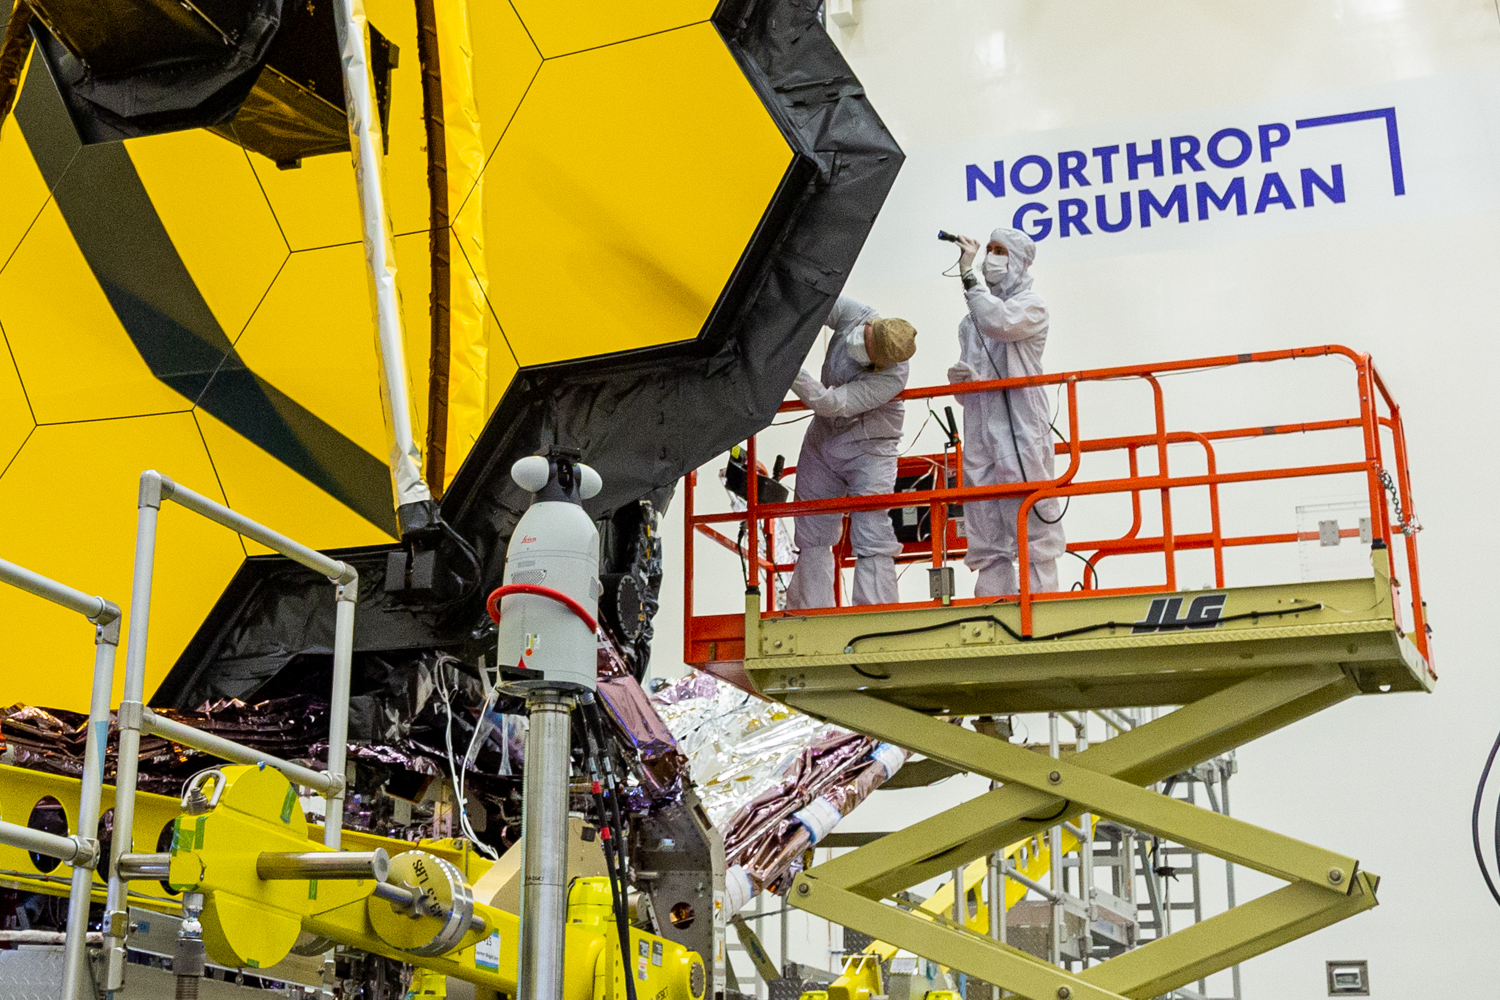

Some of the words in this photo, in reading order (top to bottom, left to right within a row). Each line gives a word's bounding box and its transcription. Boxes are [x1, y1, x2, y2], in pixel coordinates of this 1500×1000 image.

[966, 122, 1291, 202] NORTHROP
[1012, 164, 1346, 242] GRUMMAN
[1131, 594, 1227, 634] JLG
[412, 859, 430, 885] LBS
